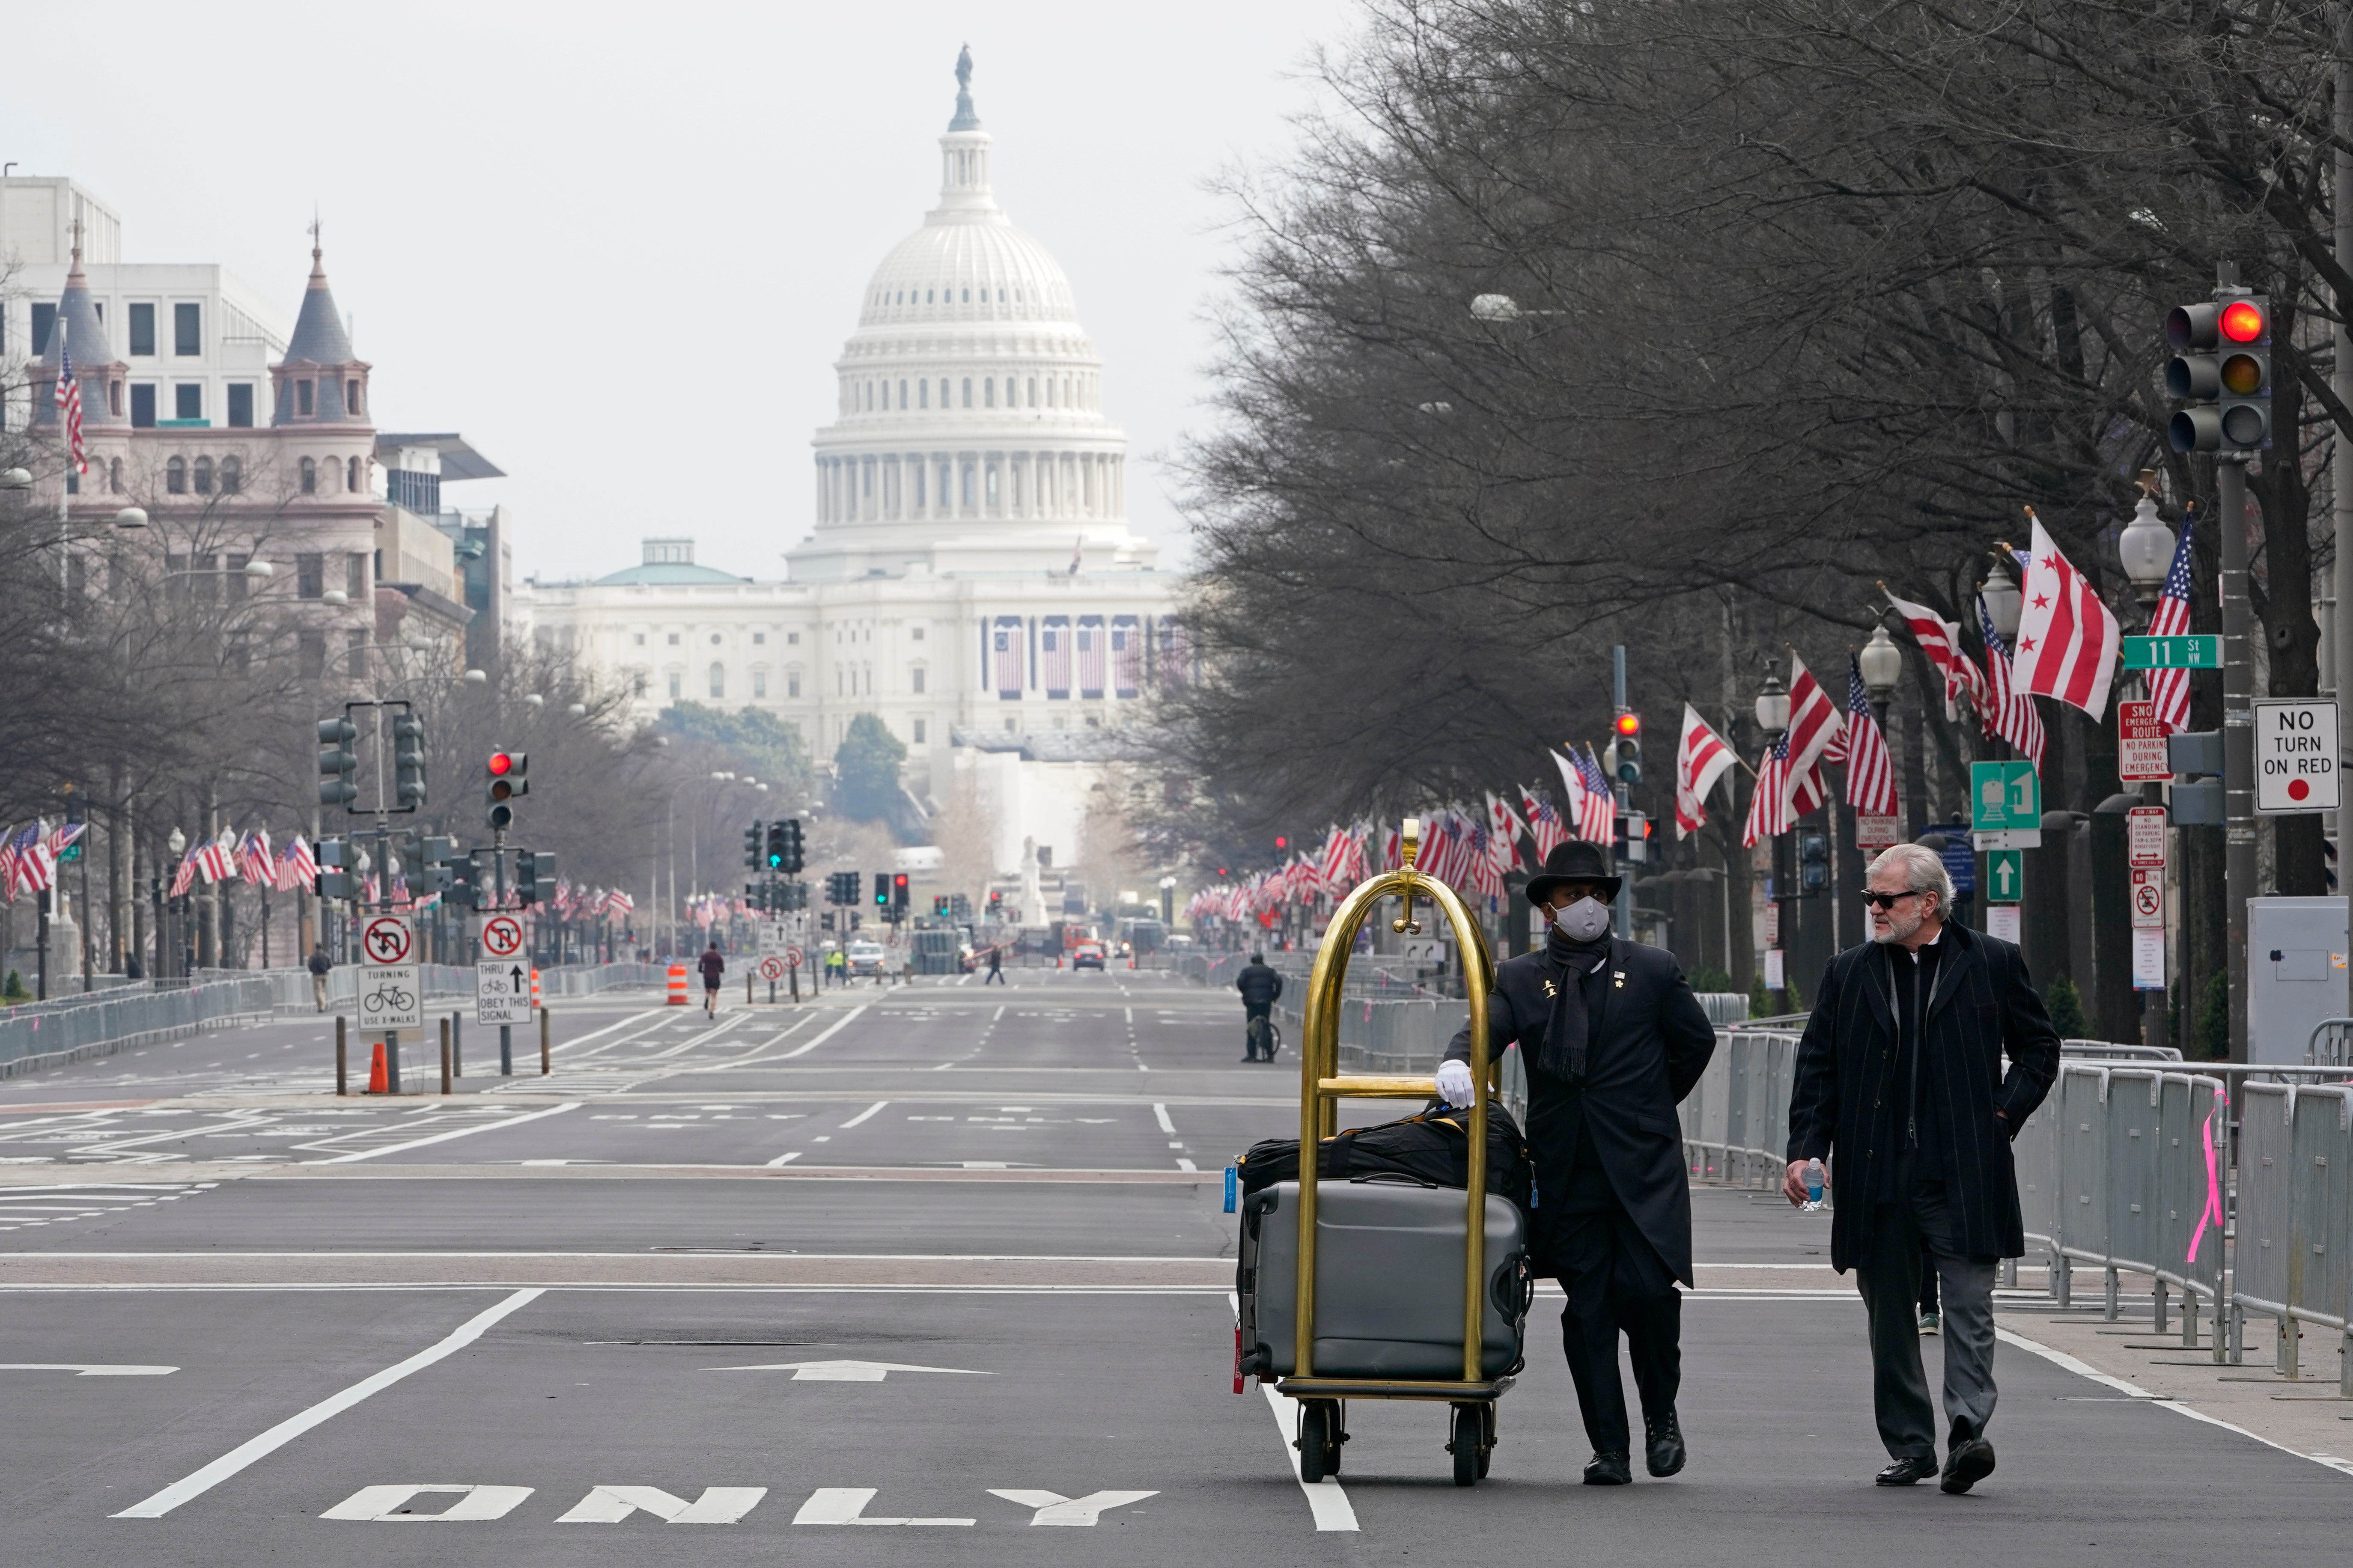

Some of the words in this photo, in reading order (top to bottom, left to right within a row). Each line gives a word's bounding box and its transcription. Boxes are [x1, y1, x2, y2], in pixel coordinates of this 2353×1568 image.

[2149, 641, 2170, 665] 11
[2188, 640, 2199, 651] St
[2188, 652, 2200, 664] NW
[2132, 705, 2153, 717] SNO
[2126, 717, 2158, 726] EMERGEN
[2280, 711, 2314, 730] NO
[2133, 726, 2161, 738] ROUTE
[2127, 741, 2135, 750] NO
[2274, 736, 2321, 752] TURN
[2133, 752, 2162, 761] DURING
[2125, 763, 2168, 773] EMERGENCY
[2264, 759, 2287, 774] ON
[2298, 758, 2331, 774] RED
[2136, 873, 2143, 882] NO
[368, 970, 410, 980] TURNING
[480, 964, 503, 974] THRU
[480, 998, 504, 1009] OBEY
[508, 997, 528, 1007] THIS
[364, 1016, 378, 1025] USE
[382, 1015, 416, 1024] X-WALKS
[481, 1009, 513, 1021] SIGNAL
[319, 1484, 1161, 1526] ONLY
